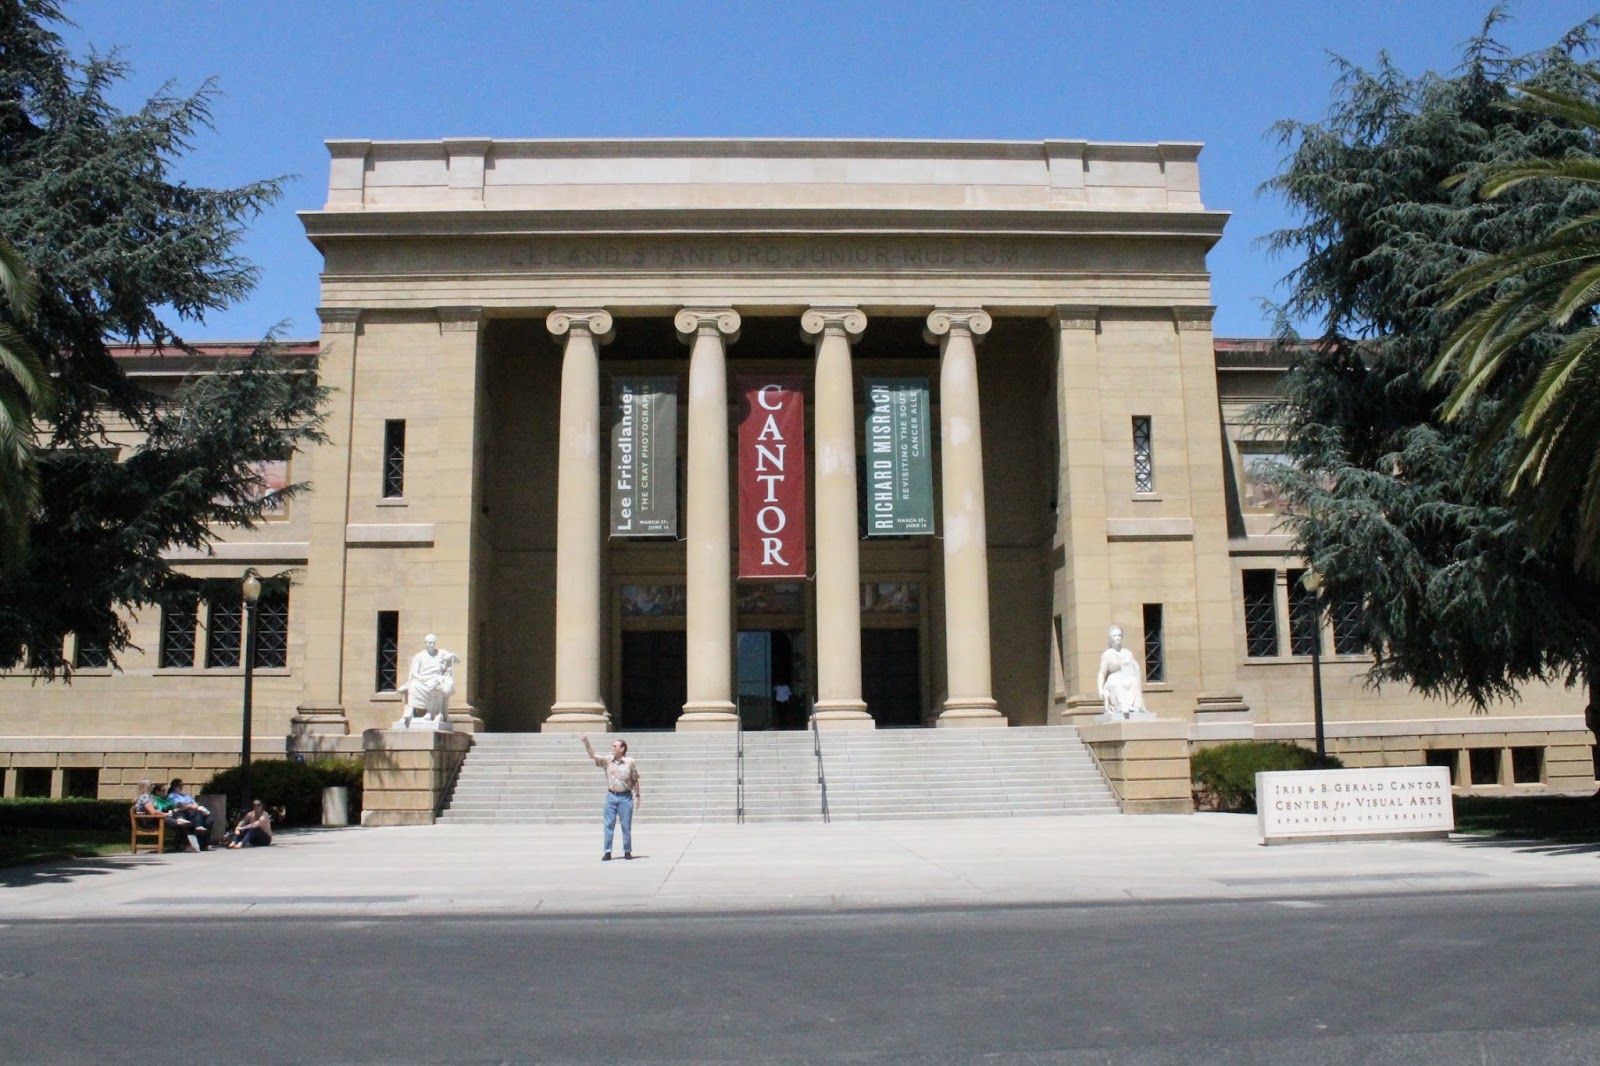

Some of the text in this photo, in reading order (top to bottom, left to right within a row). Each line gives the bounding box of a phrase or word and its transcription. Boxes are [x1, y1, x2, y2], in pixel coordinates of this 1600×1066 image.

[631, 246, 780, 264] STANFORD
[795, 246, 891, 263] JUNIOR
[903, 246, 1019, 264] MUSEUM
[617, 385, 633, 530] Lee Friedlander
[641, 385, 649, 511] THE CRAY PHOTOGRAPHS
[871, 385, 893, 529] RICHARD MISRACH
[899, 385, 910, 500] REVISITING THE SOUTH
[909, 385, 919, 457] CANCER ALLEY
[755, 384, 789, 566] CANTOR
[1275, 785, 1303, 795] IRIS
[1334, 783, 1384, 793] GERALD
[1390, 781, 1441, 791] CANTOR
[1275, 796, 1442, 812] CENTER for VISUAL ARTS
[1277, 812, 1442, 824] STANFORD UNIVERSITY
